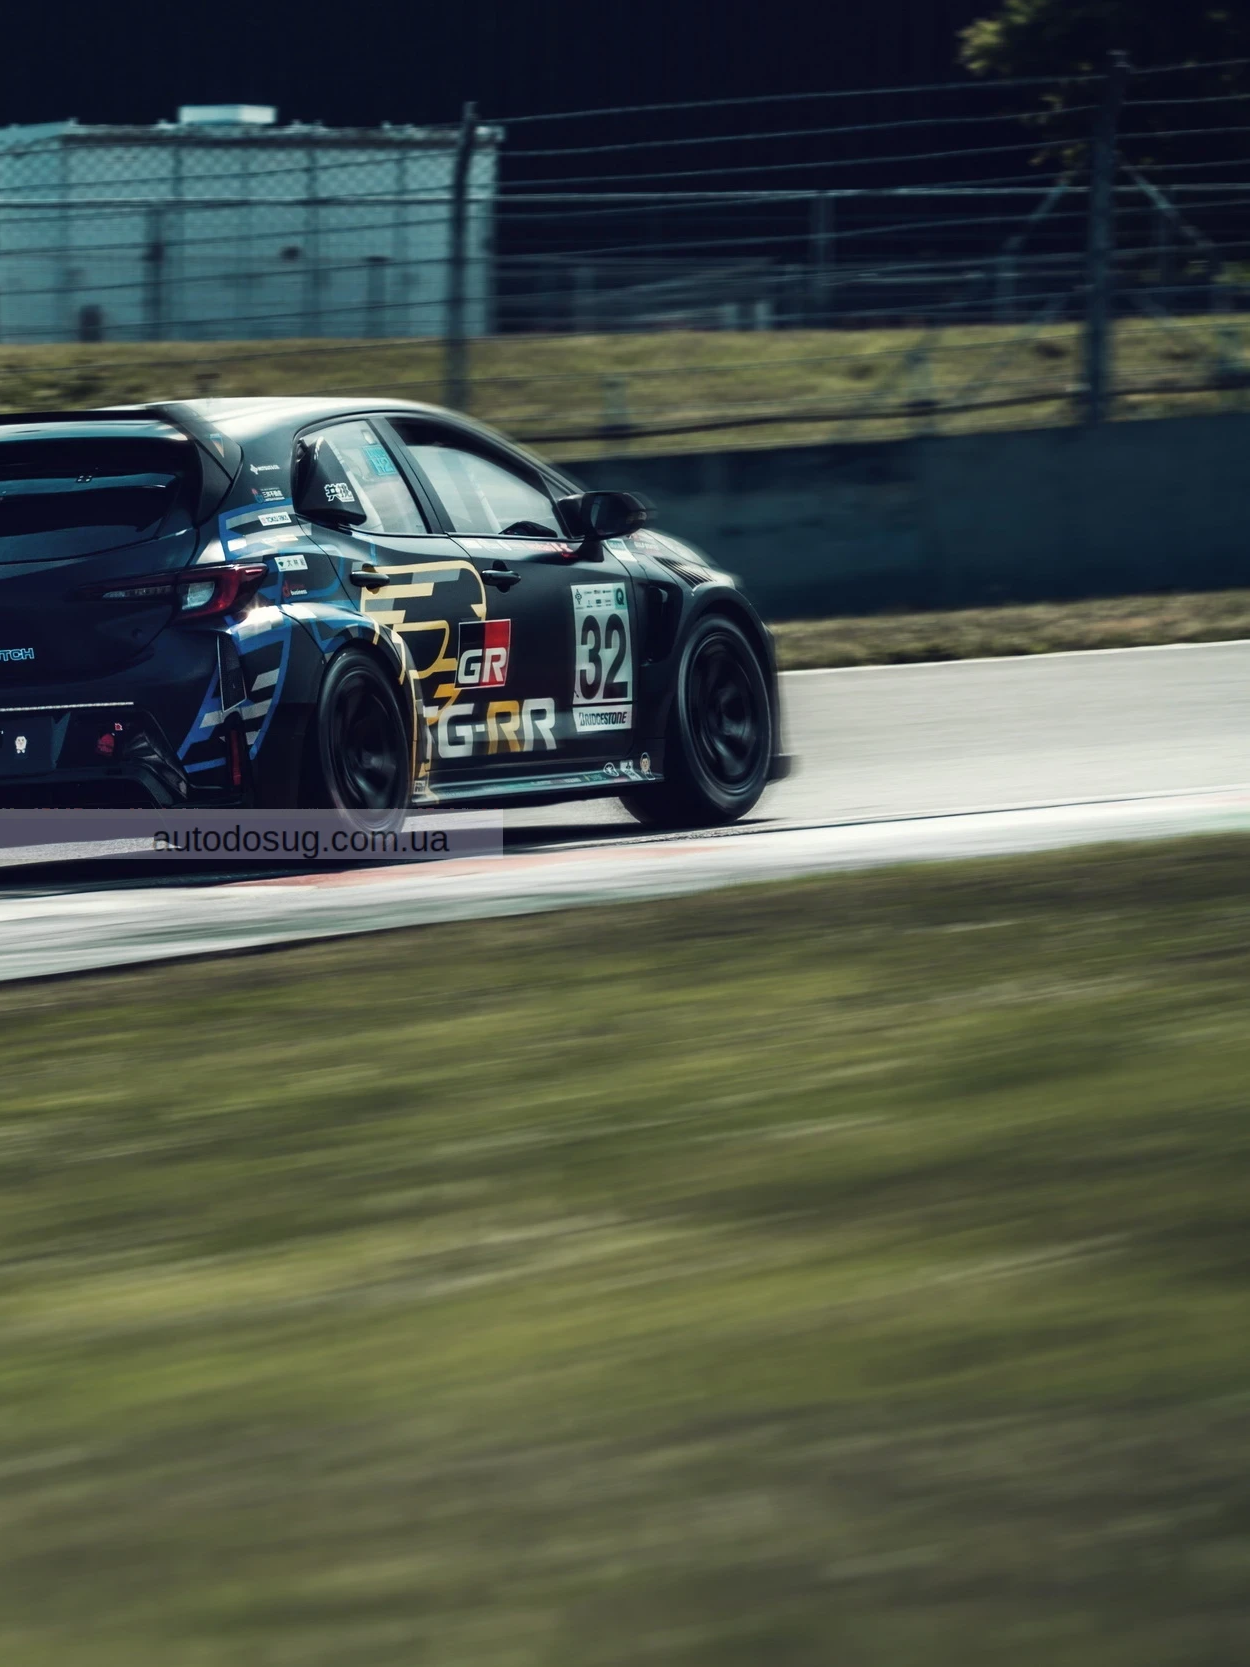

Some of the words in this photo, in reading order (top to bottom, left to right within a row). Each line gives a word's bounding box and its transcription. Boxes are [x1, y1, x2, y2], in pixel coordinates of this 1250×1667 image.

[615, 587, 625, 606] Q
[457, 647, 508, 685] GR
[579, 613, 629, 700] 32
[578, 711, 628, 727] BRIDGESTONE
